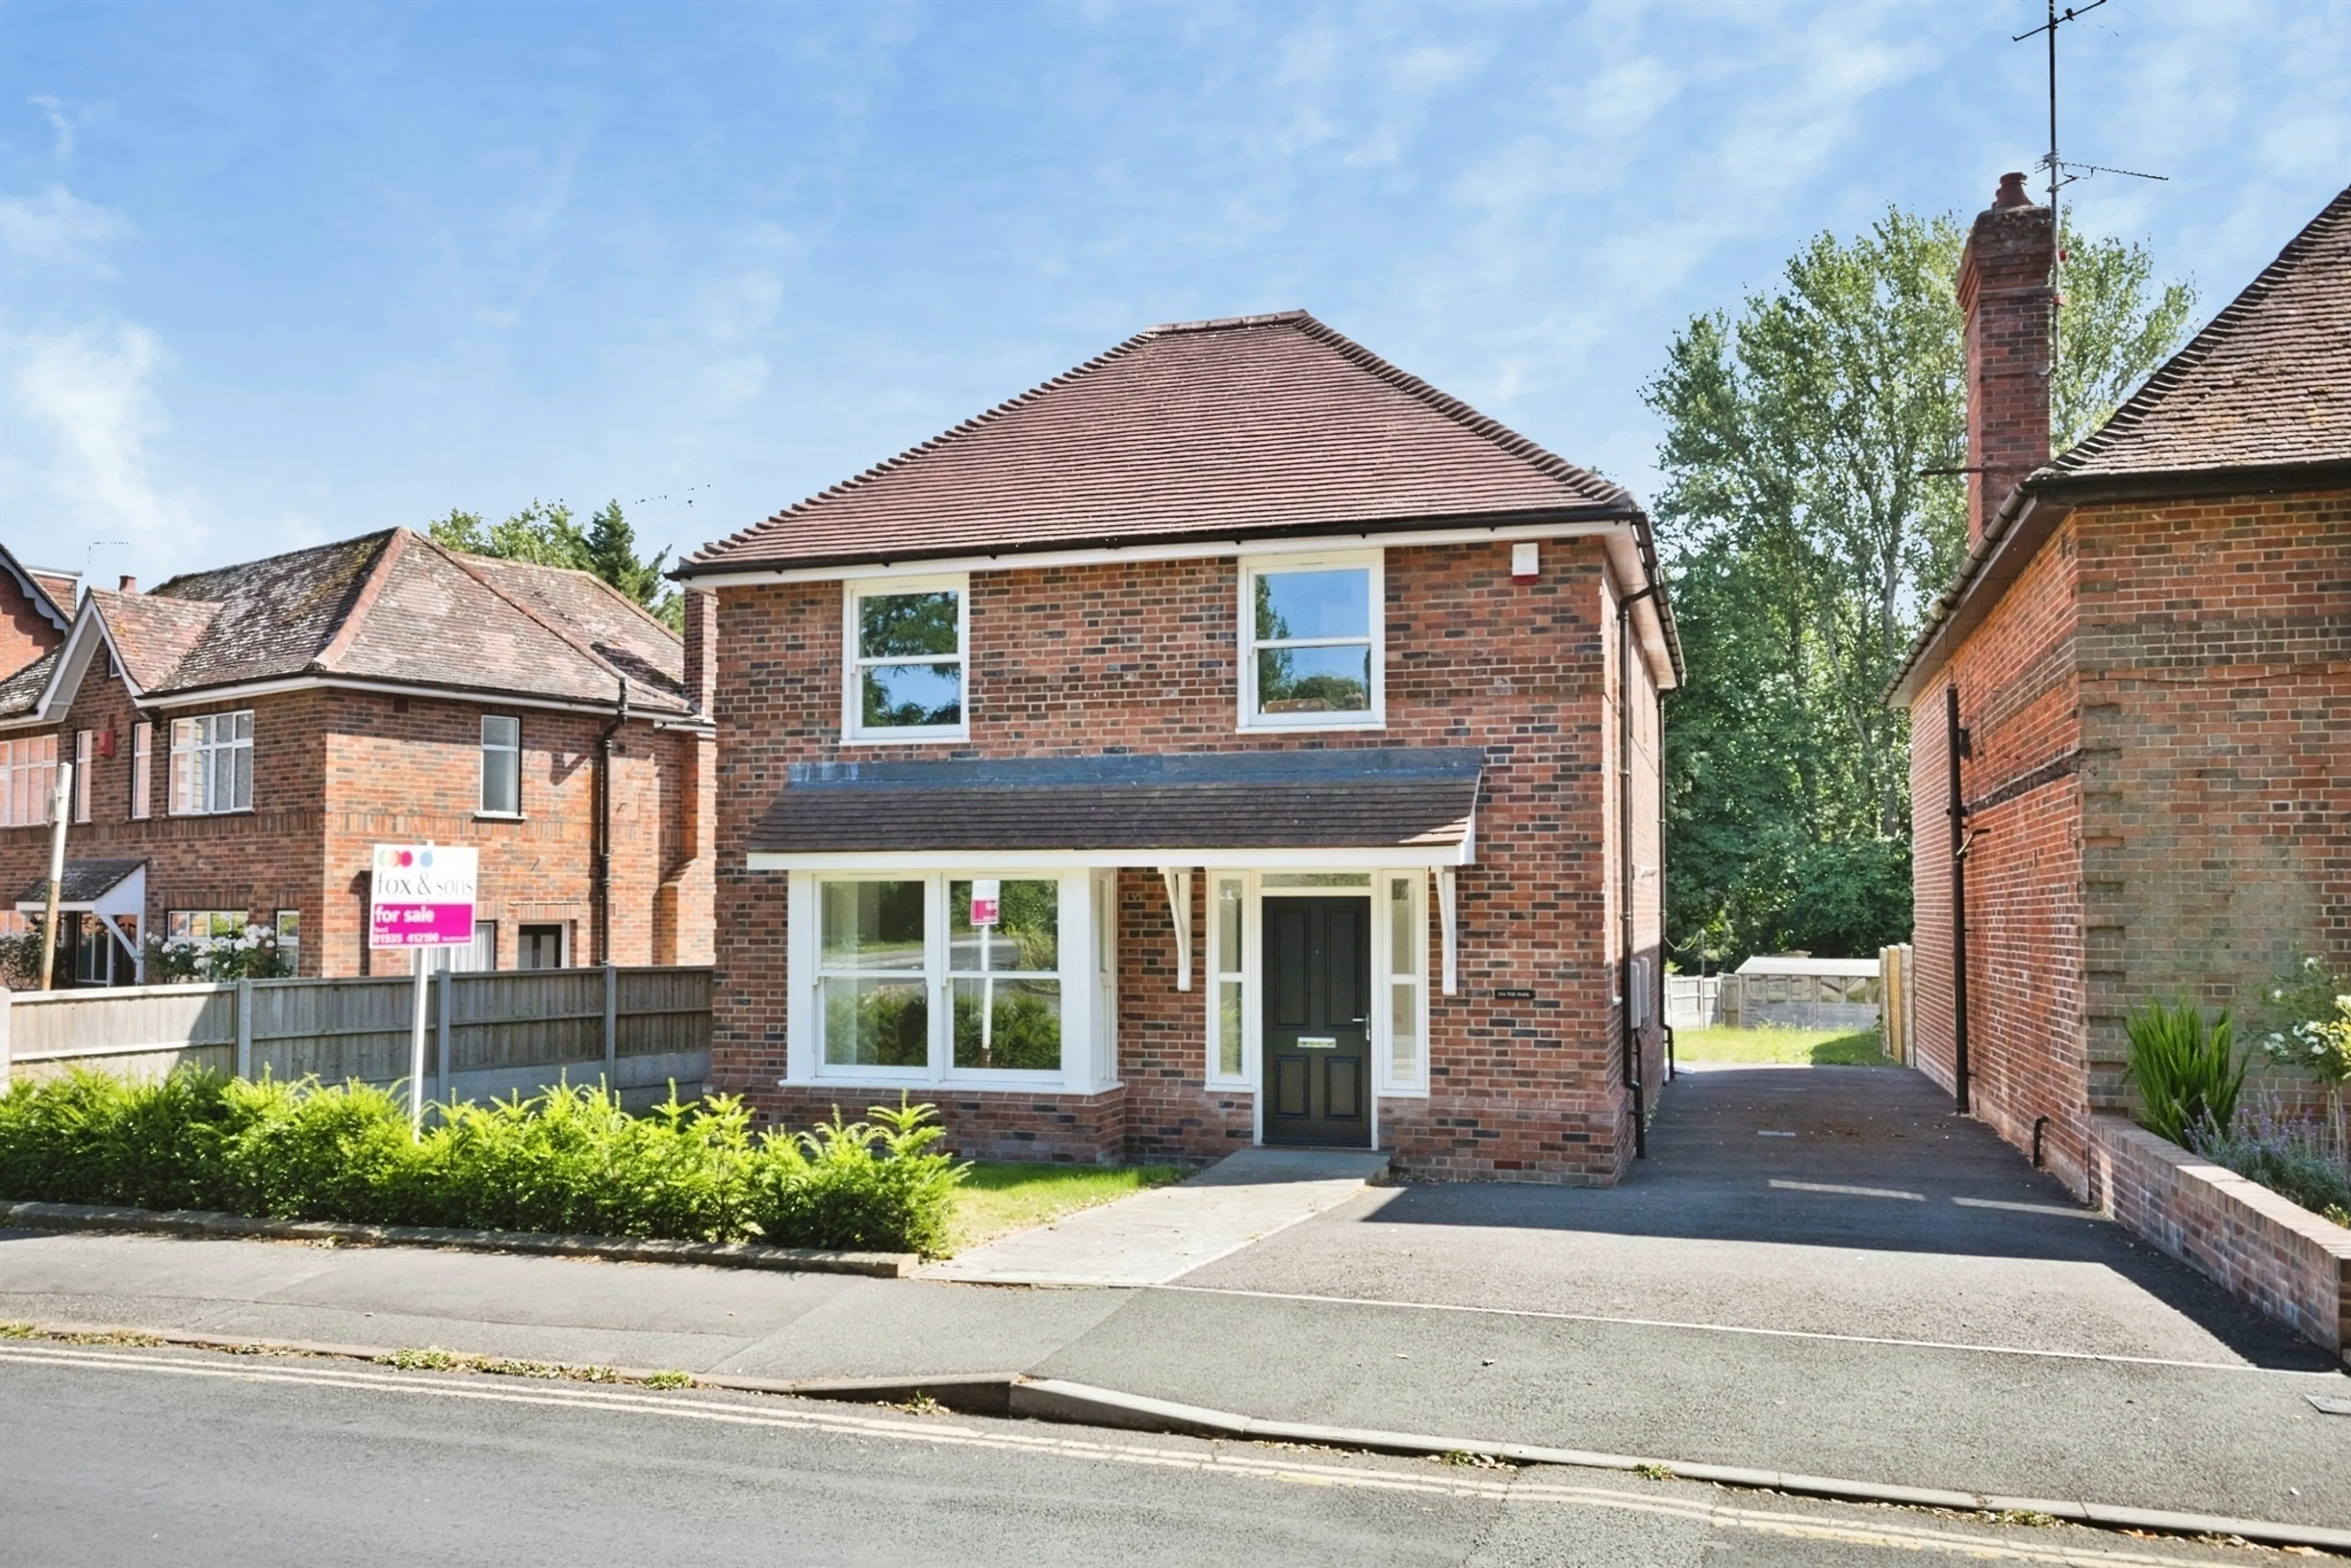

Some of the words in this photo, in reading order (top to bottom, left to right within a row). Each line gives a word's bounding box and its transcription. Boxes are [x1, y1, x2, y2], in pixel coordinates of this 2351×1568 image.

[378, 871, 411, 895] fox
[418, 871, 432, 896] &
[436, 879, 473, 896] sons
[375, 905, 400, 923] for
[403, 905, 435, 923] sale
